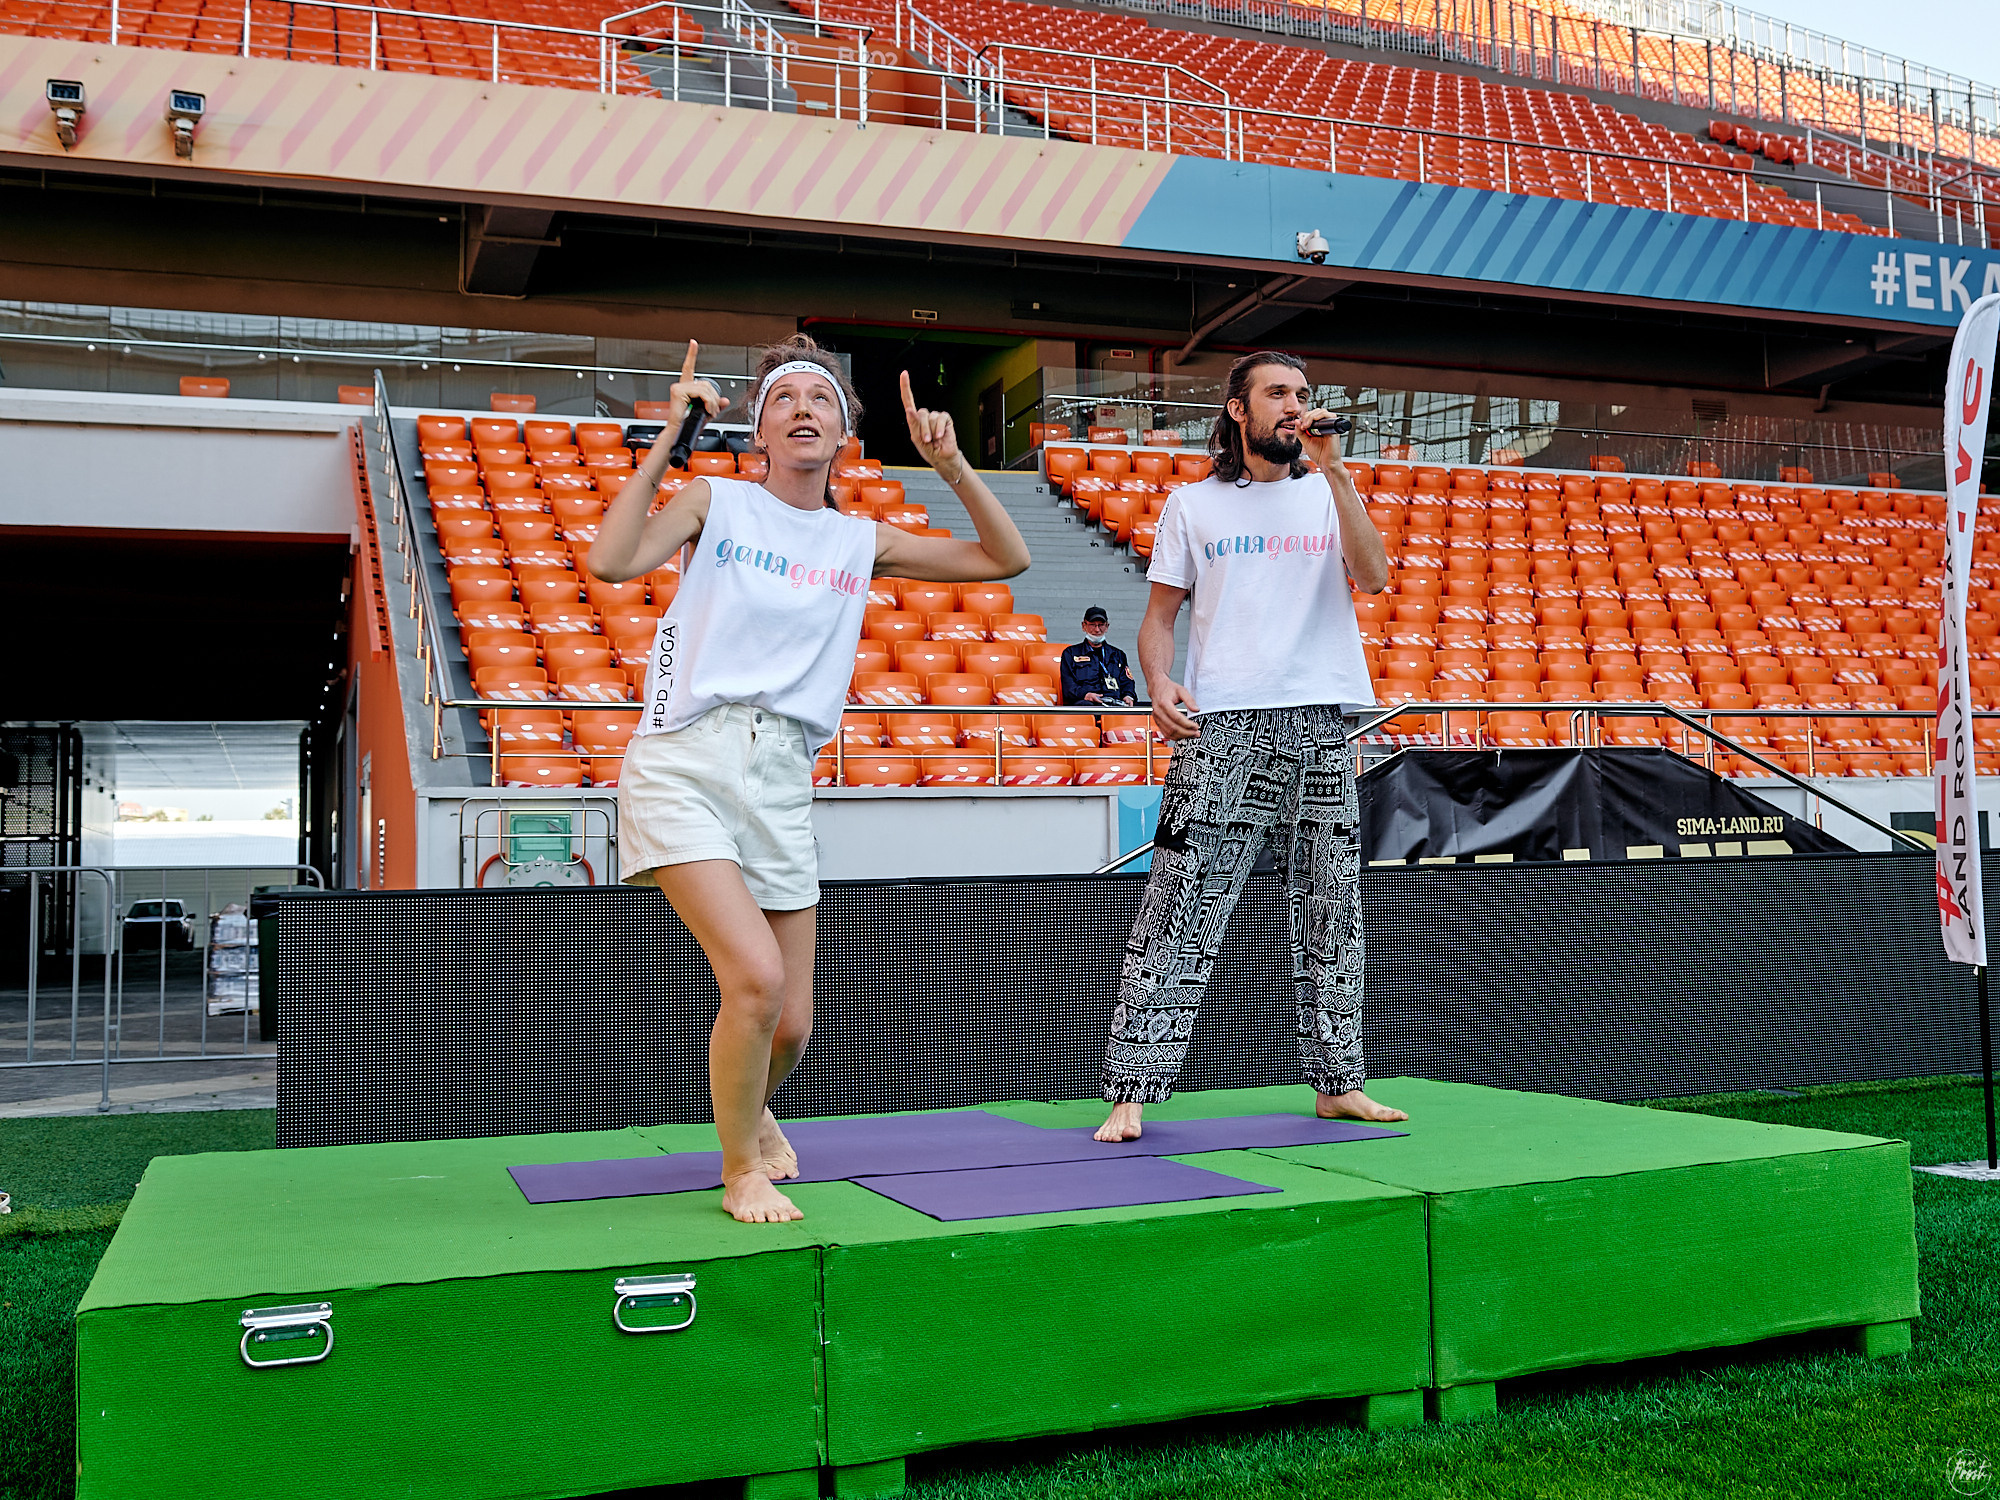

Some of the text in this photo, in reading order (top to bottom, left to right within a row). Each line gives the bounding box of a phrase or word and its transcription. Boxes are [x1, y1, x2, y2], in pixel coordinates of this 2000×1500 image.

[1035, 486, 1043, 494] 12
[652, 625, 676, 729] #DD_YOGA
[1676, 816, 1784, 835] SIMA-LAND.RU
